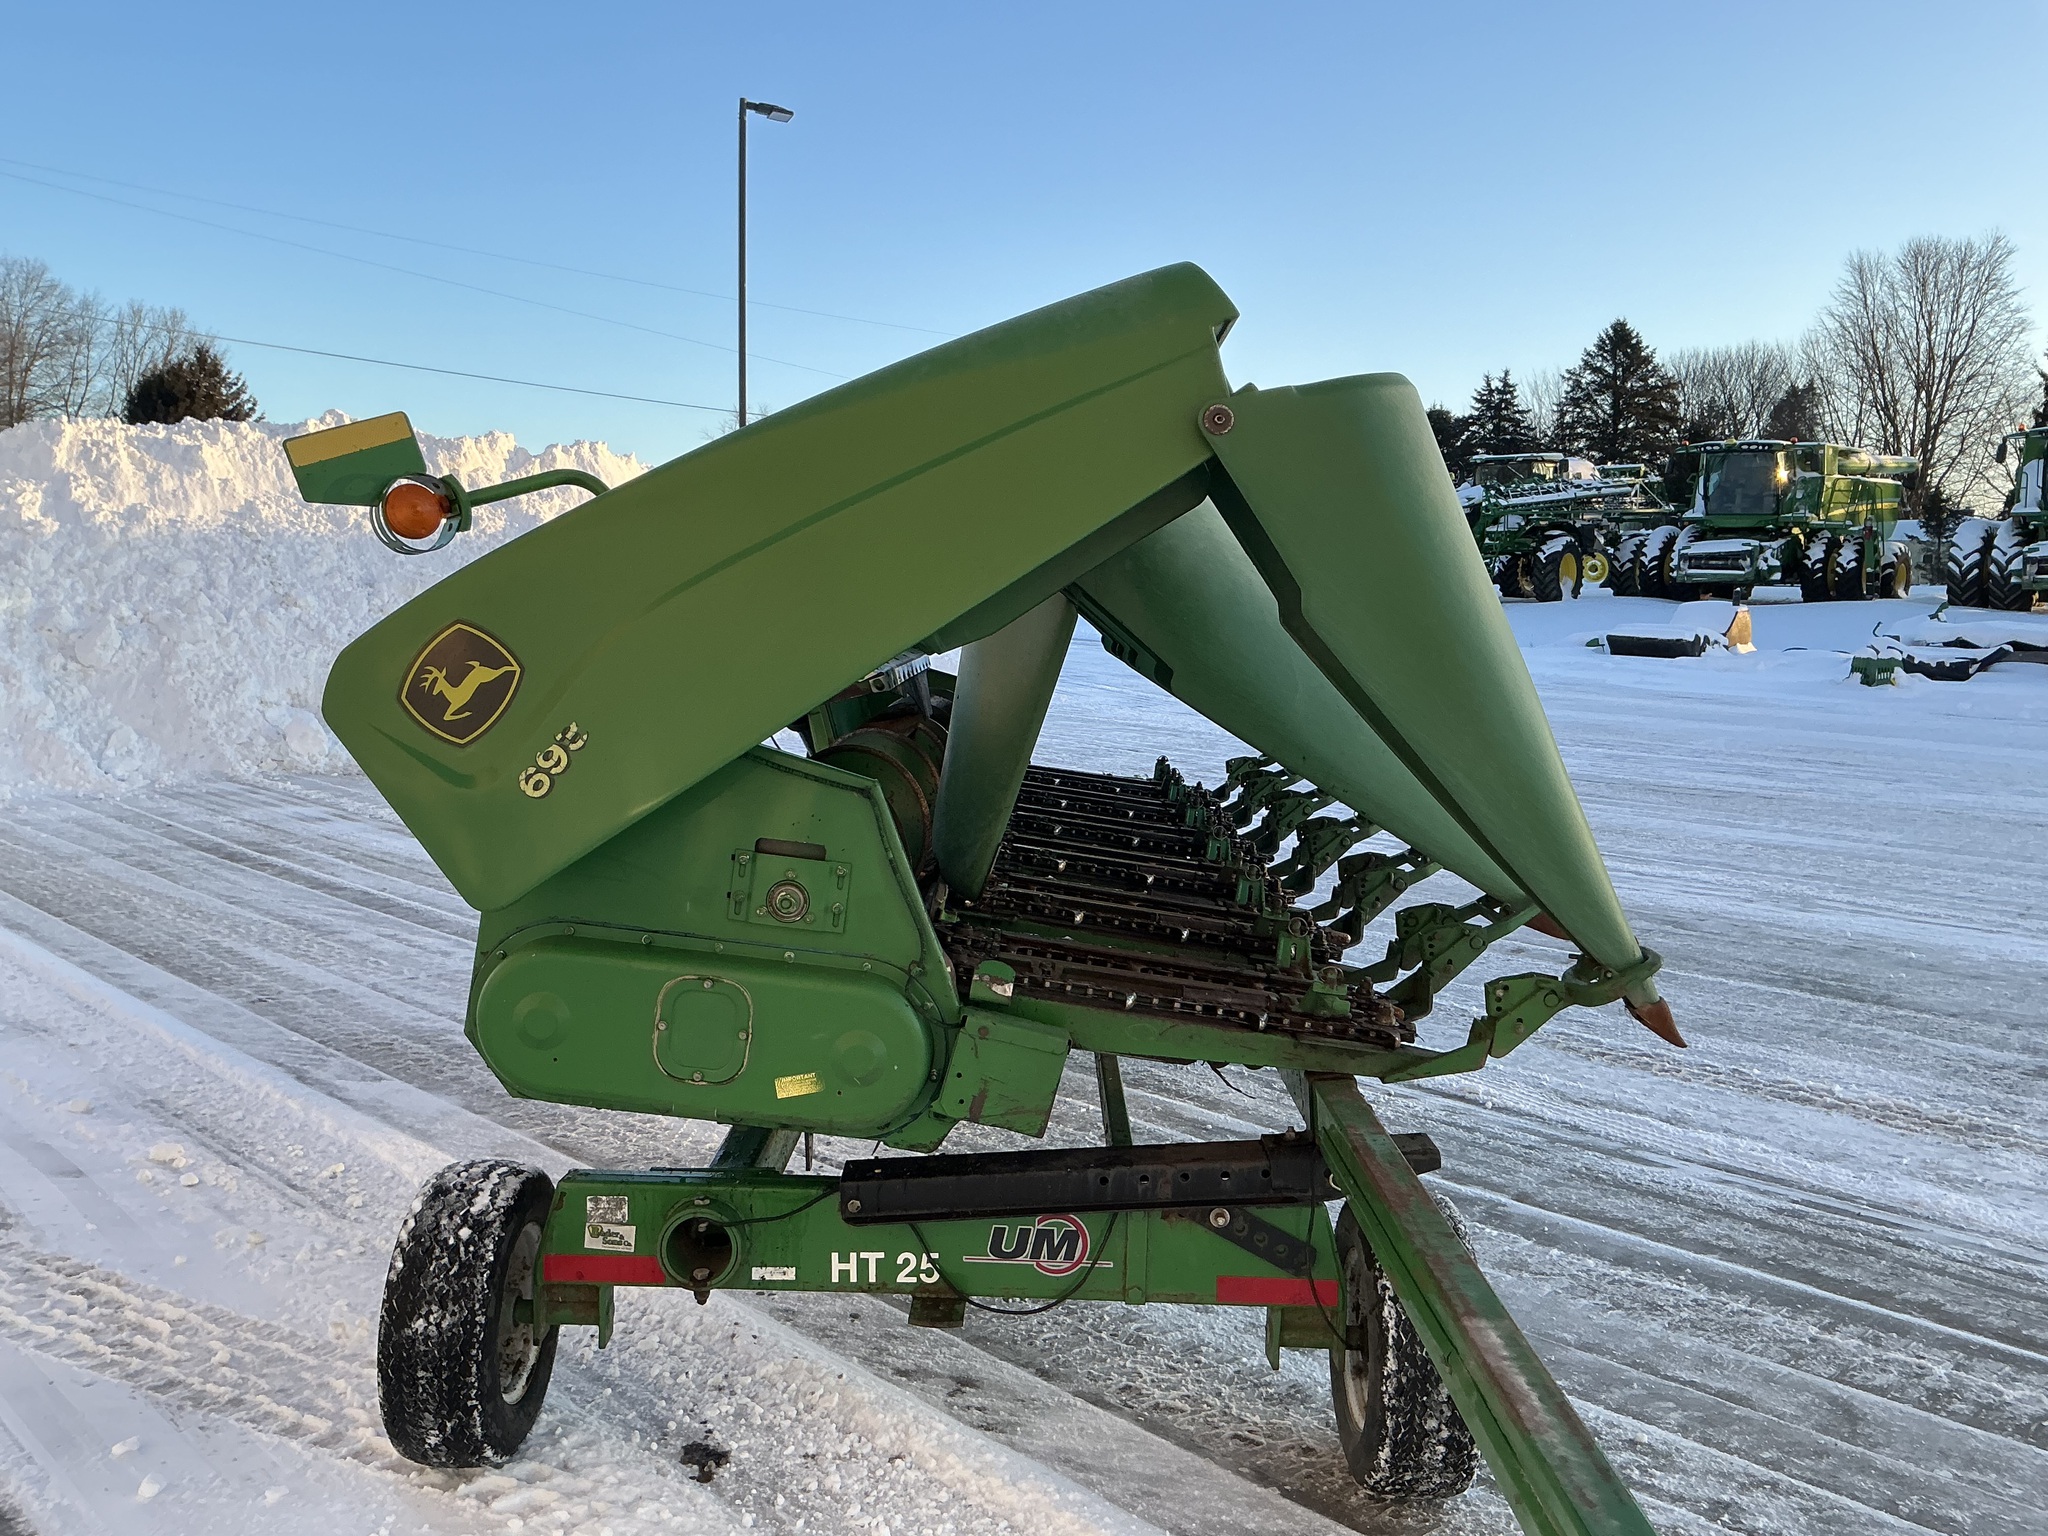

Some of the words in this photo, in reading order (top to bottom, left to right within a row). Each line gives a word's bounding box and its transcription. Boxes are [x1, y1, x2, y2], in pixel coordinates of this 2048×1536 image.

[781, 1072, 816, 1083] IMPORTANT
[988, 1225, 1082, 1261] UM
[831, 1252, 885, 1283] HT
[896, 1252, 941, 1284] 25
